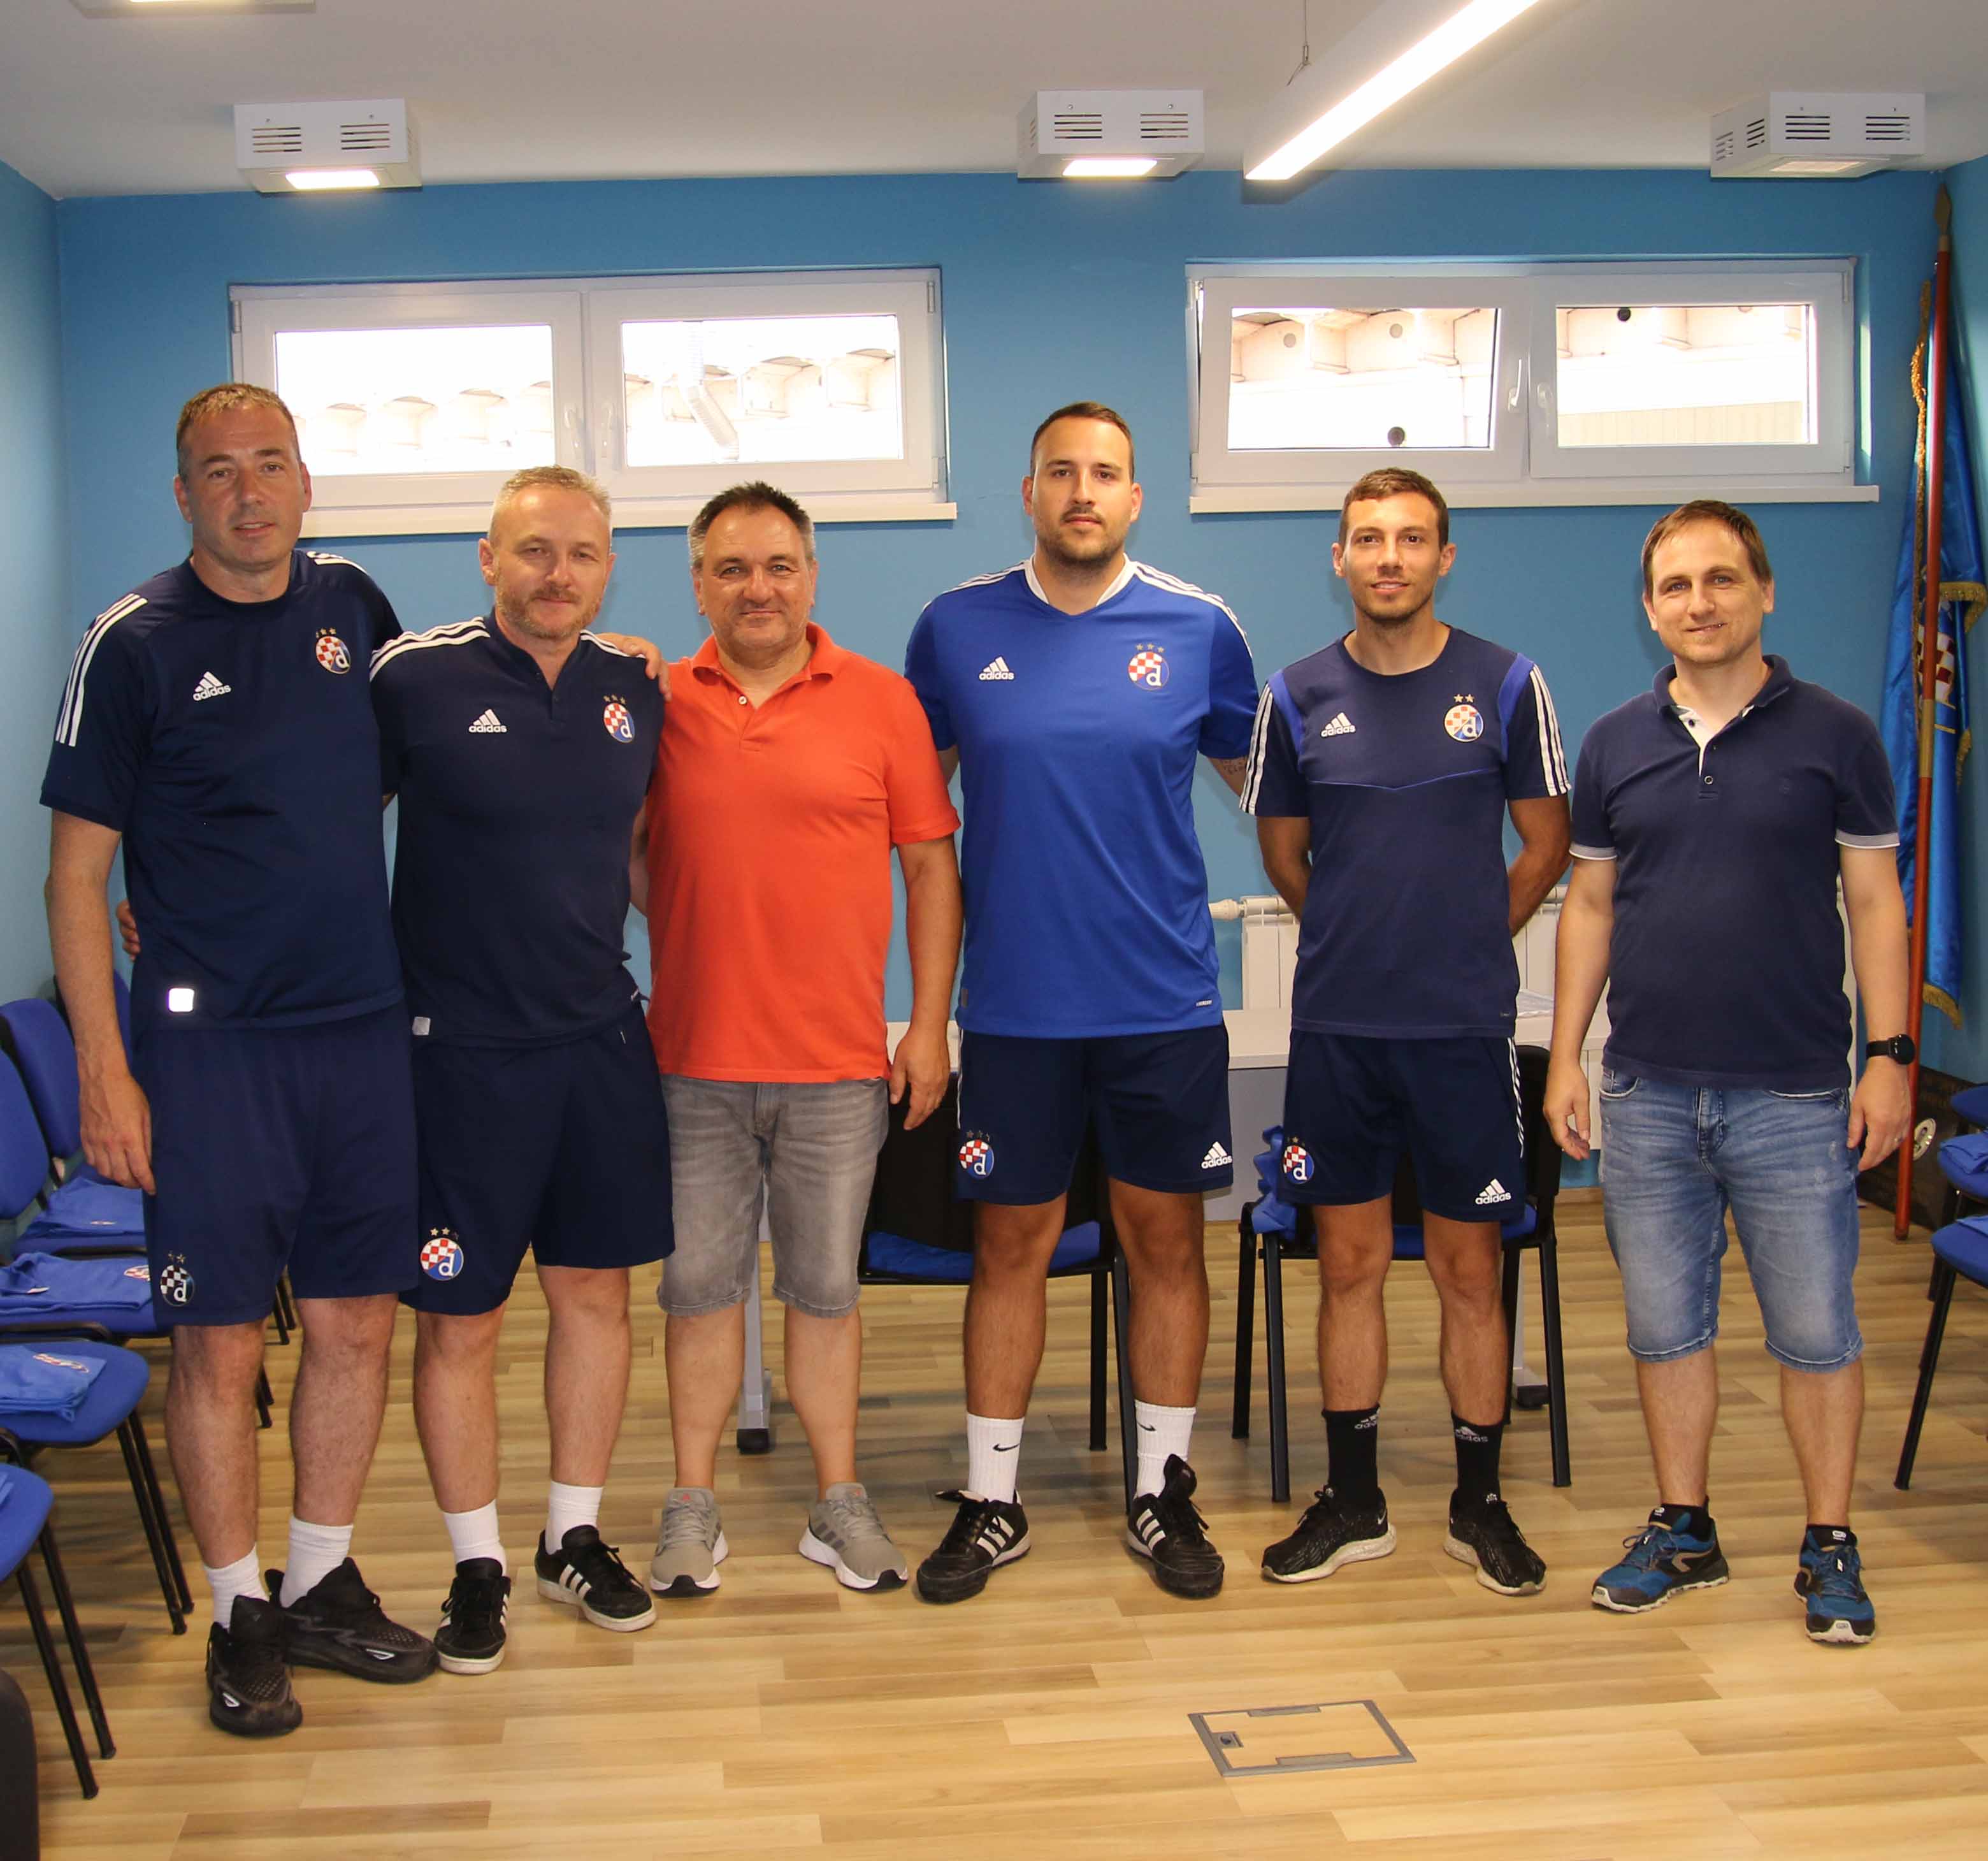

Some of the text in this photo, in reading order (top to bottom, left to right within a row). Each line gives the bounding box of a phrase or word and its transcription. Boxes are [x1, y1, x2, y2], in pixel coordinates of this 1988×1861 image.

[979, 671, 1014, 681] adidas
[193, 684, 231, 701] adidas
[469, 724, 507, 733] adidas
[1321, 725, 1357, 737] adidas
[1201, 1155, 1232, 1169] adidas
[1475, 1192, 1511, 1205] adidas
